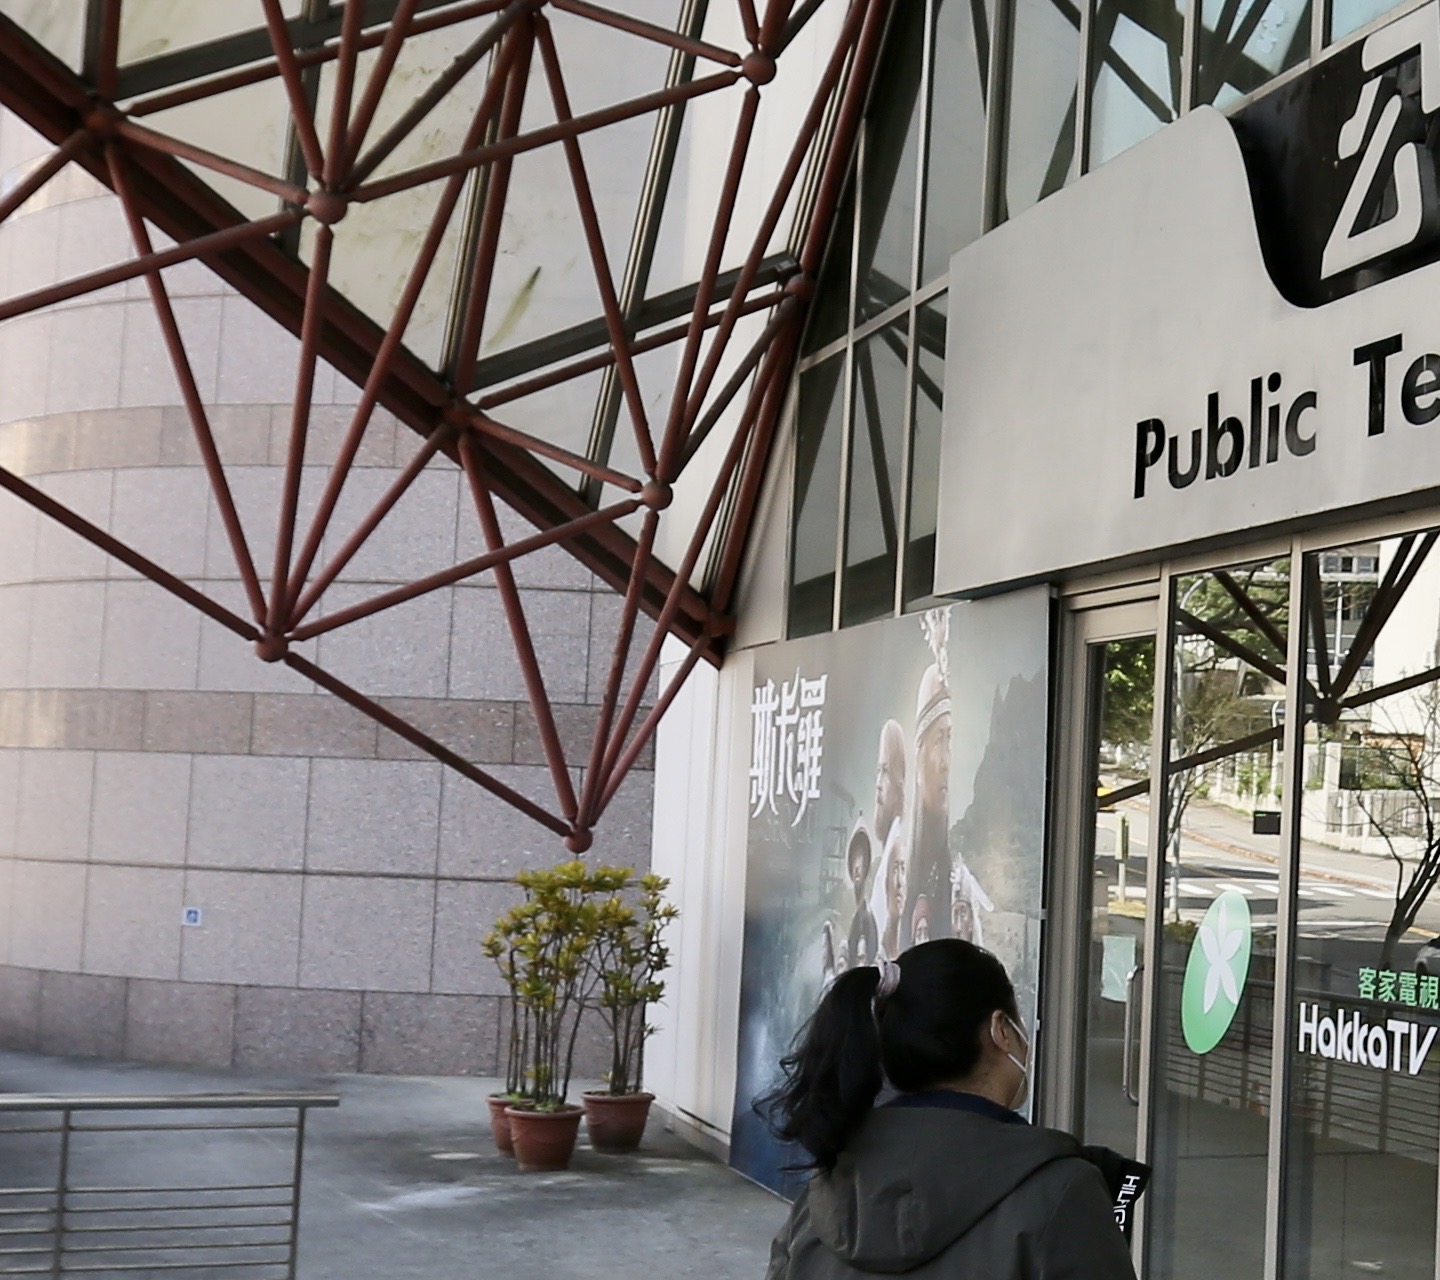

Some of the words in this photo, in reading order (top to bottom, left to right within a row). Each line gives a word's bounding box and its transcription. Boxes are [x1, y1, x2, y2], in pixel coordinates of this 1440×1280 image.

[1134, 373, 1317, 499] Public
[749, 666, 828, 827] 斯卡羅
[1358, 967, 1440, 1010] 客家電視
[1298, 1002, 1438, 1075] HakkaTV
